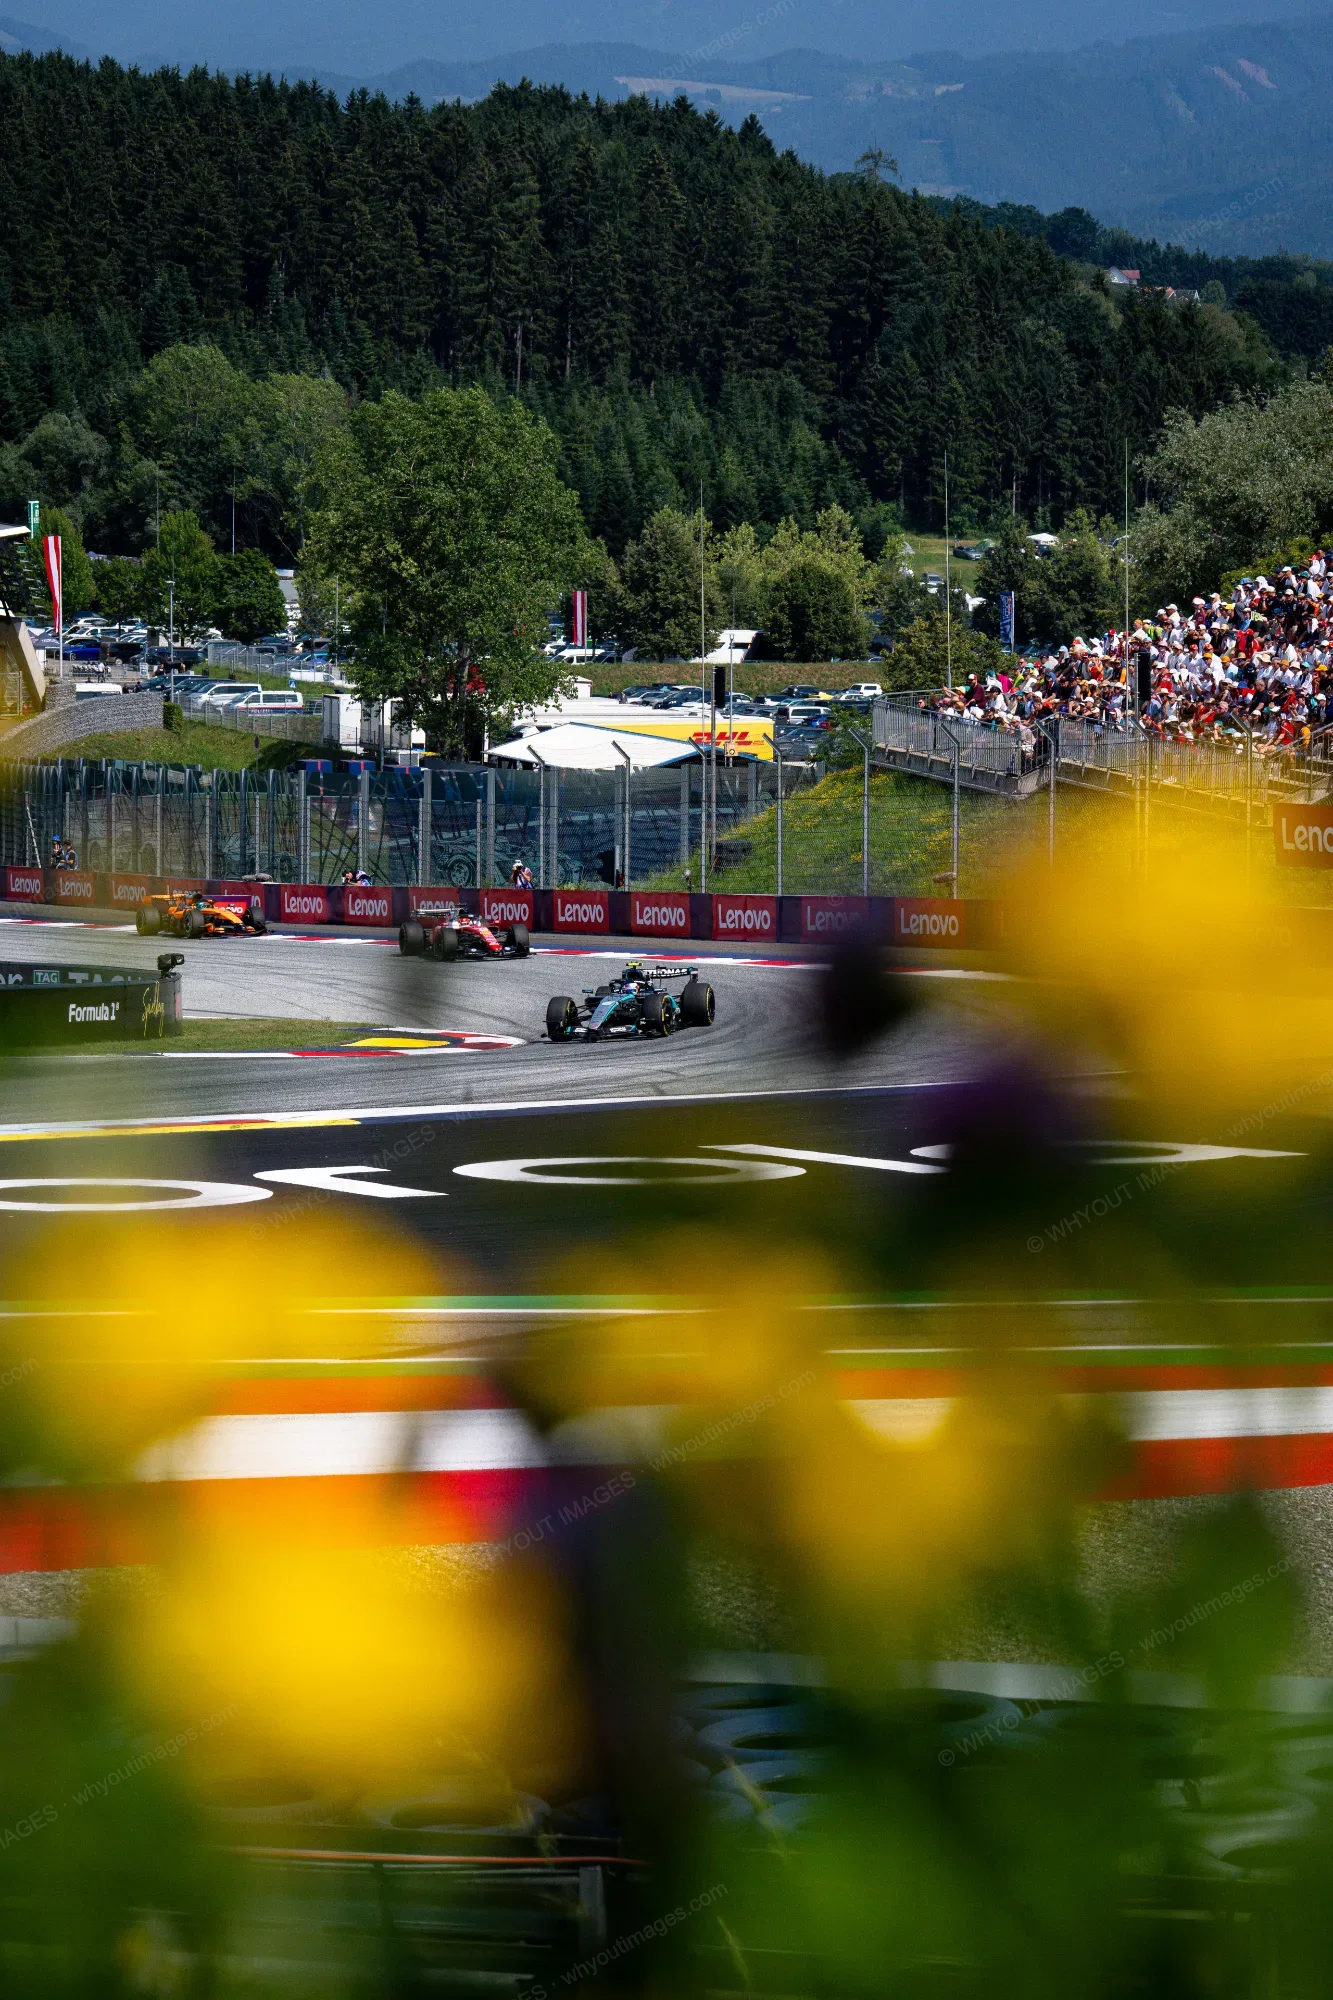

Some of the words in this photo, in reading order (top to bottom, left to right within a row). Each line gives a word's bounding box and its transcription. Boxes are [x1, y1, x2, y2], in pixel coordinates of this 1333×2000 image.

[692, 732, 754, 746] DHL
[10, 873, 41, 894] Lenovo
[59, 877, 92, 897] Lenovo
[112, 880, 146, 902] Lenovo
[284, 892, 323, 914] Lenovo
[348, 894, 388, 917] Lenovo
[484, 899, 529, 922] Lenovo
[557, 899, 604, 923] Lenovo
[636, 901, 686, 927] Lenovo
[718, 904, 771, 930] Lenovo
[899, 907, 959, 936] Lenovo
[35, 972, 58, 983] TAG
[68, 1003, 110, 1022] Formula
